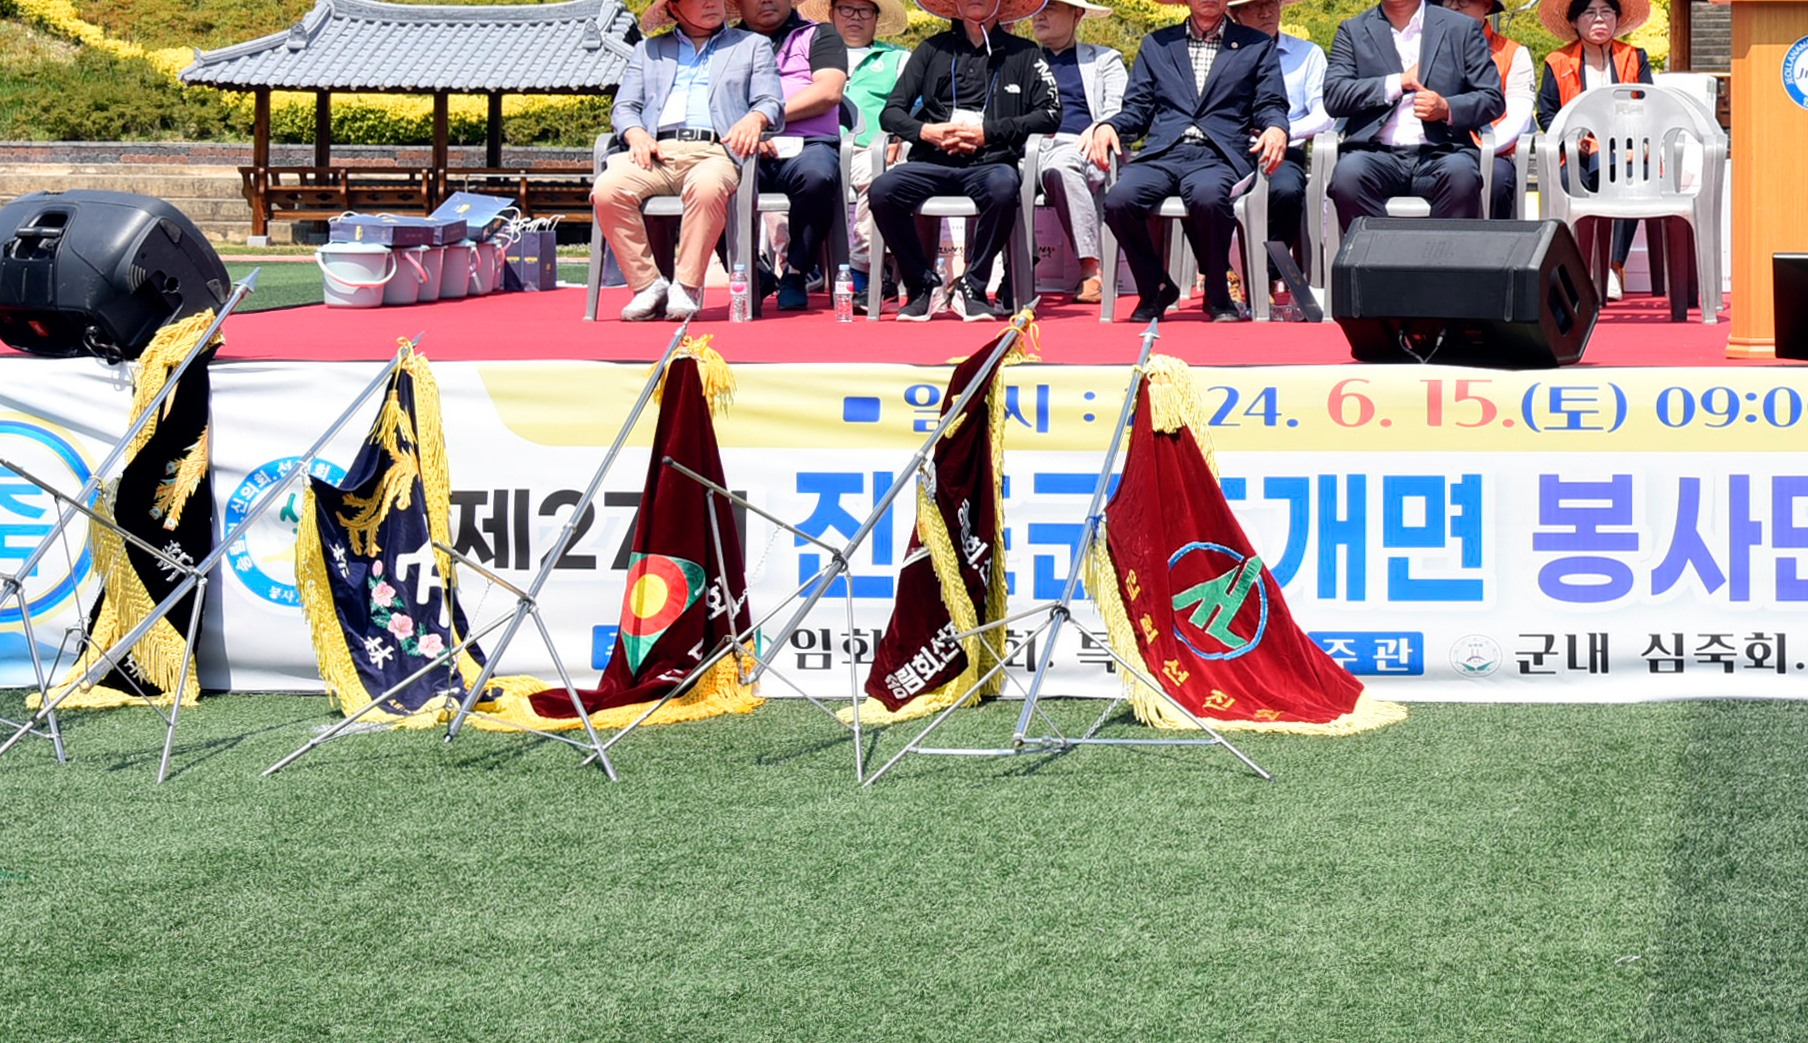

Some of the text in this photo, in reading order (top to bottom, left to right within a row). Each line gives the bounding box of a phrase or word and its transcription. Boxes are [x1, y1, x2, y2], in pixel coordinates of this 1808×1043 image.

[1327, 378, 1393, 428] 6.
[447, 488, 747, 571] 제27
[1515, 633, 1806, 675] 군내 심죽회.
